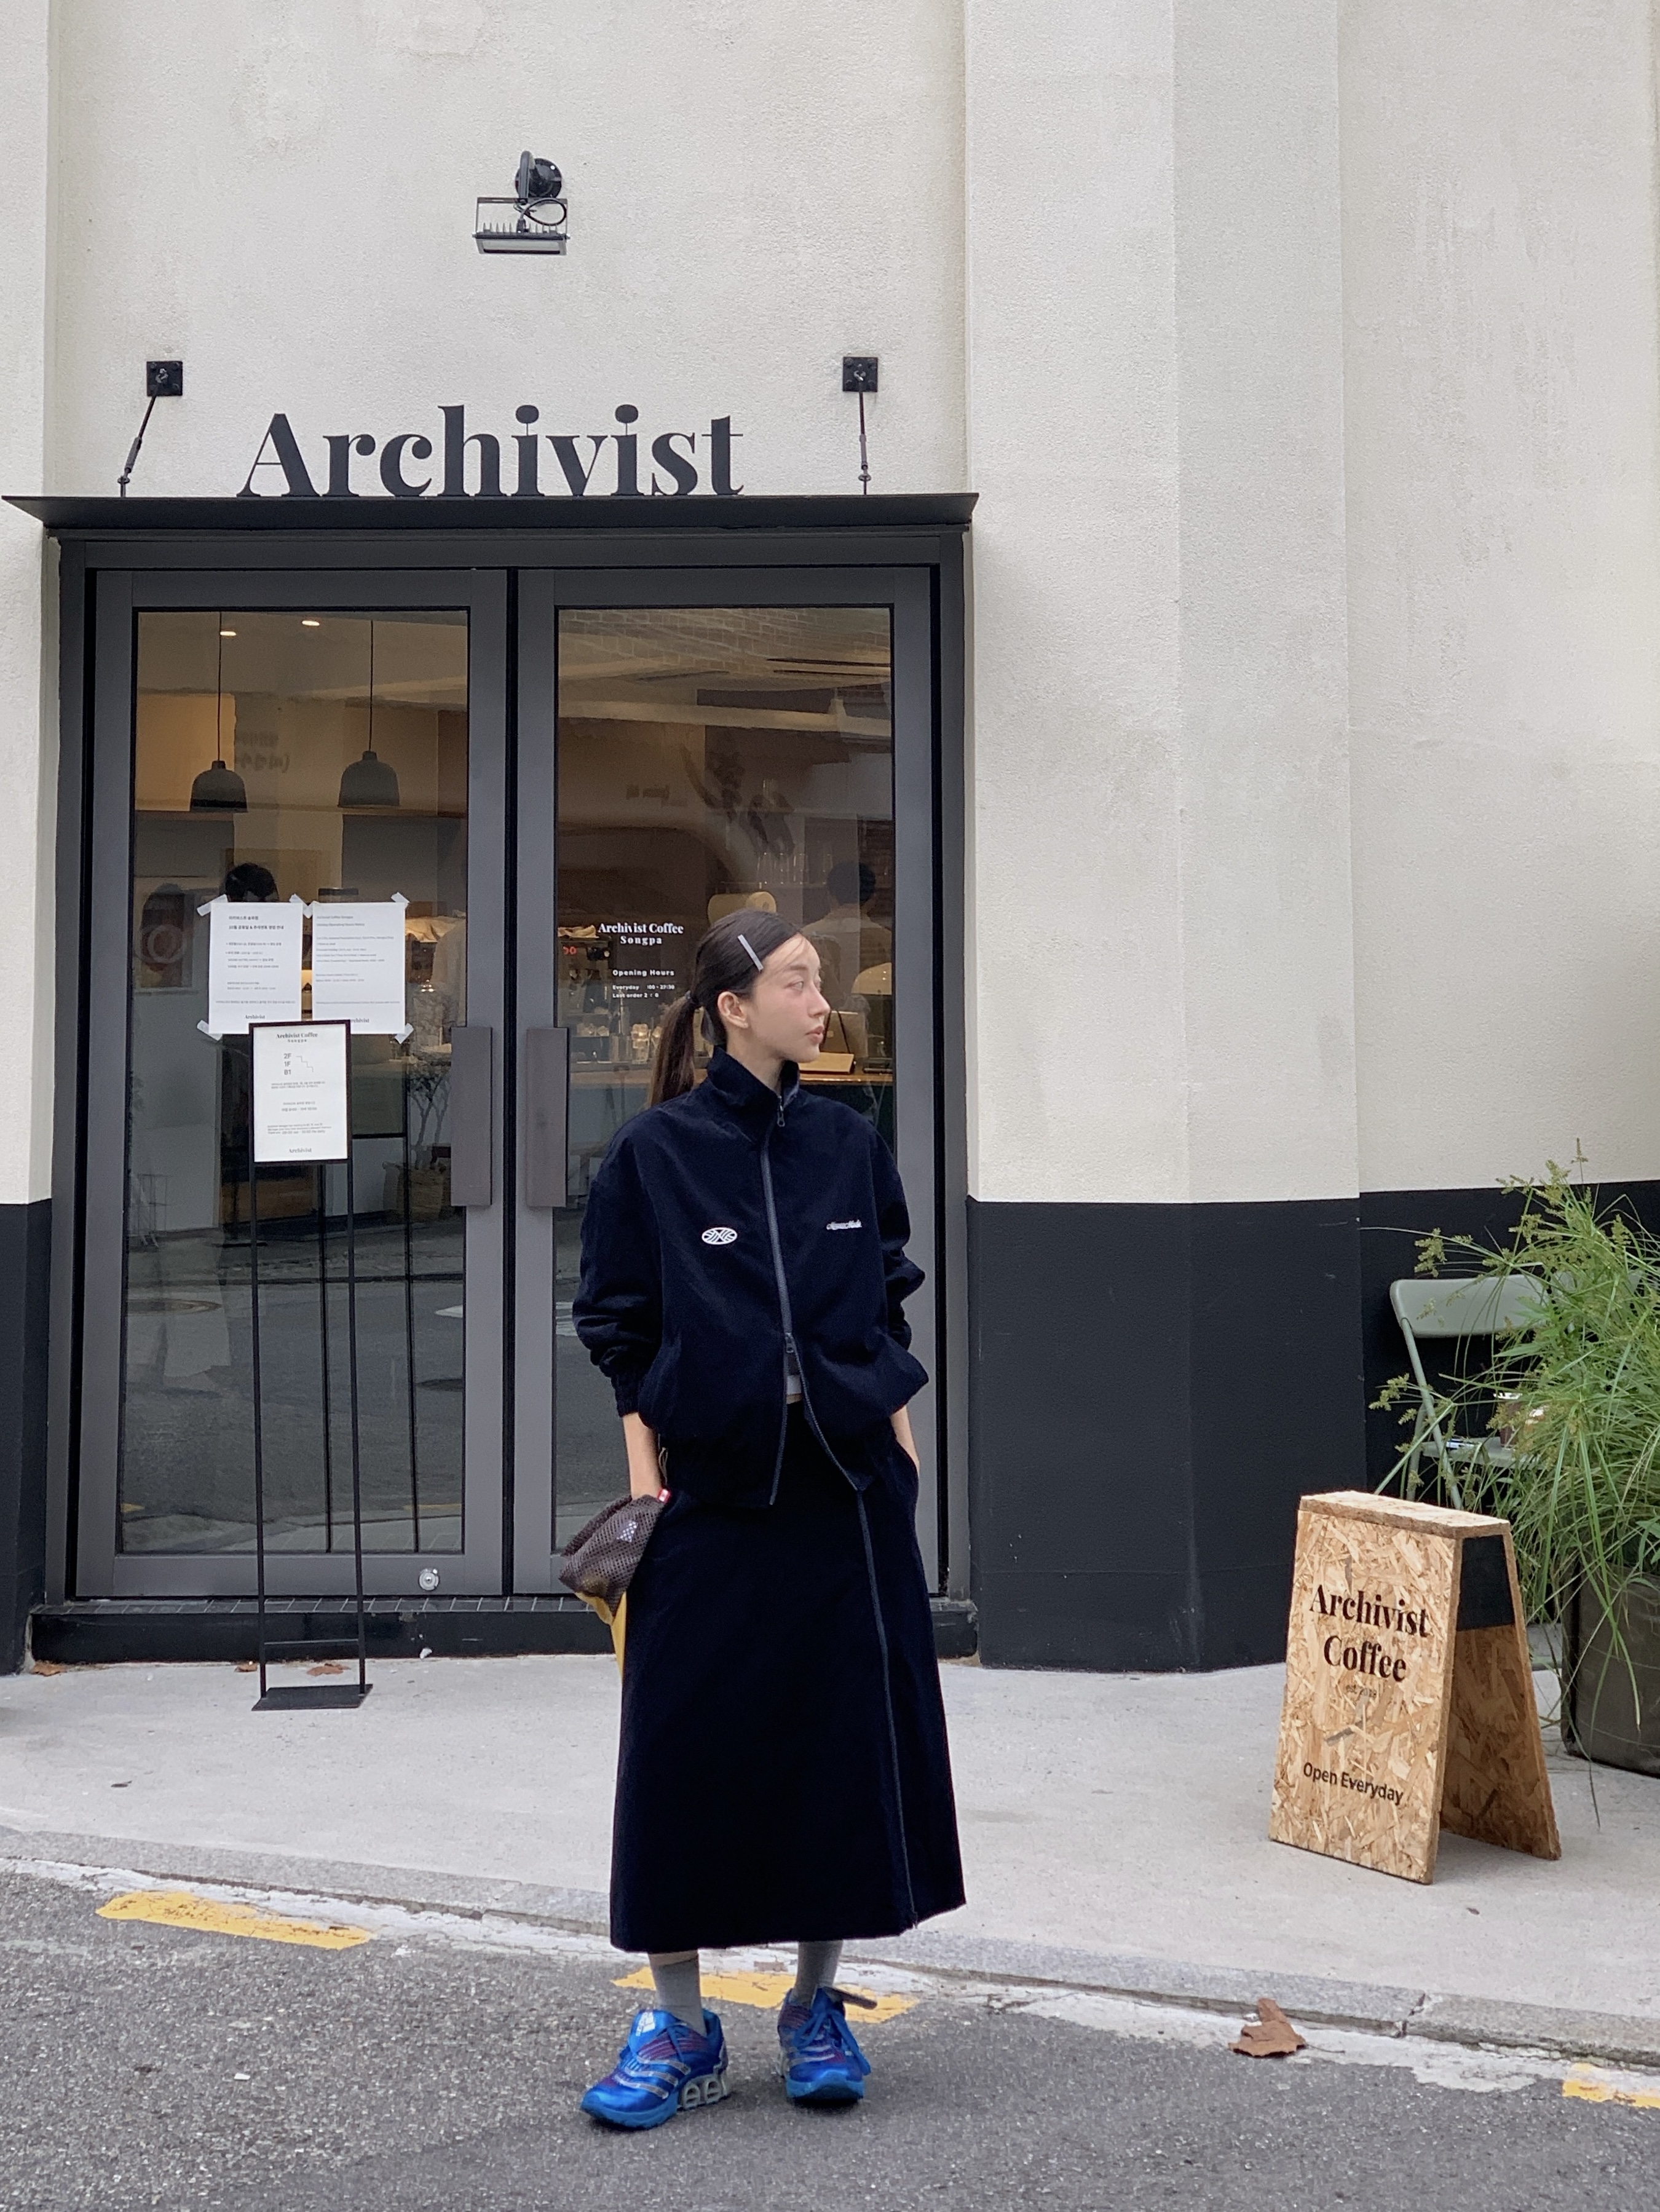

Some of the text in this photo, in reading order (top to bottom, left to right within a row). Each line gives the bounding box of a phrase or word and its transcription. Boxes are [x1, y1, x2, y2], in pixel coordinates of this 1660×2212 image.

[236, 404, 745, 496] Archivist
[598, 923, 684, 934] Archivist Coffee
[620, 936, 662, 946] Songpa
[1309, 1584, 1430, 1638] Archivist
[1324, 1635, 1407, 1682] Coffee
[1303, 1762, 1404, 1806] Open Everyday
